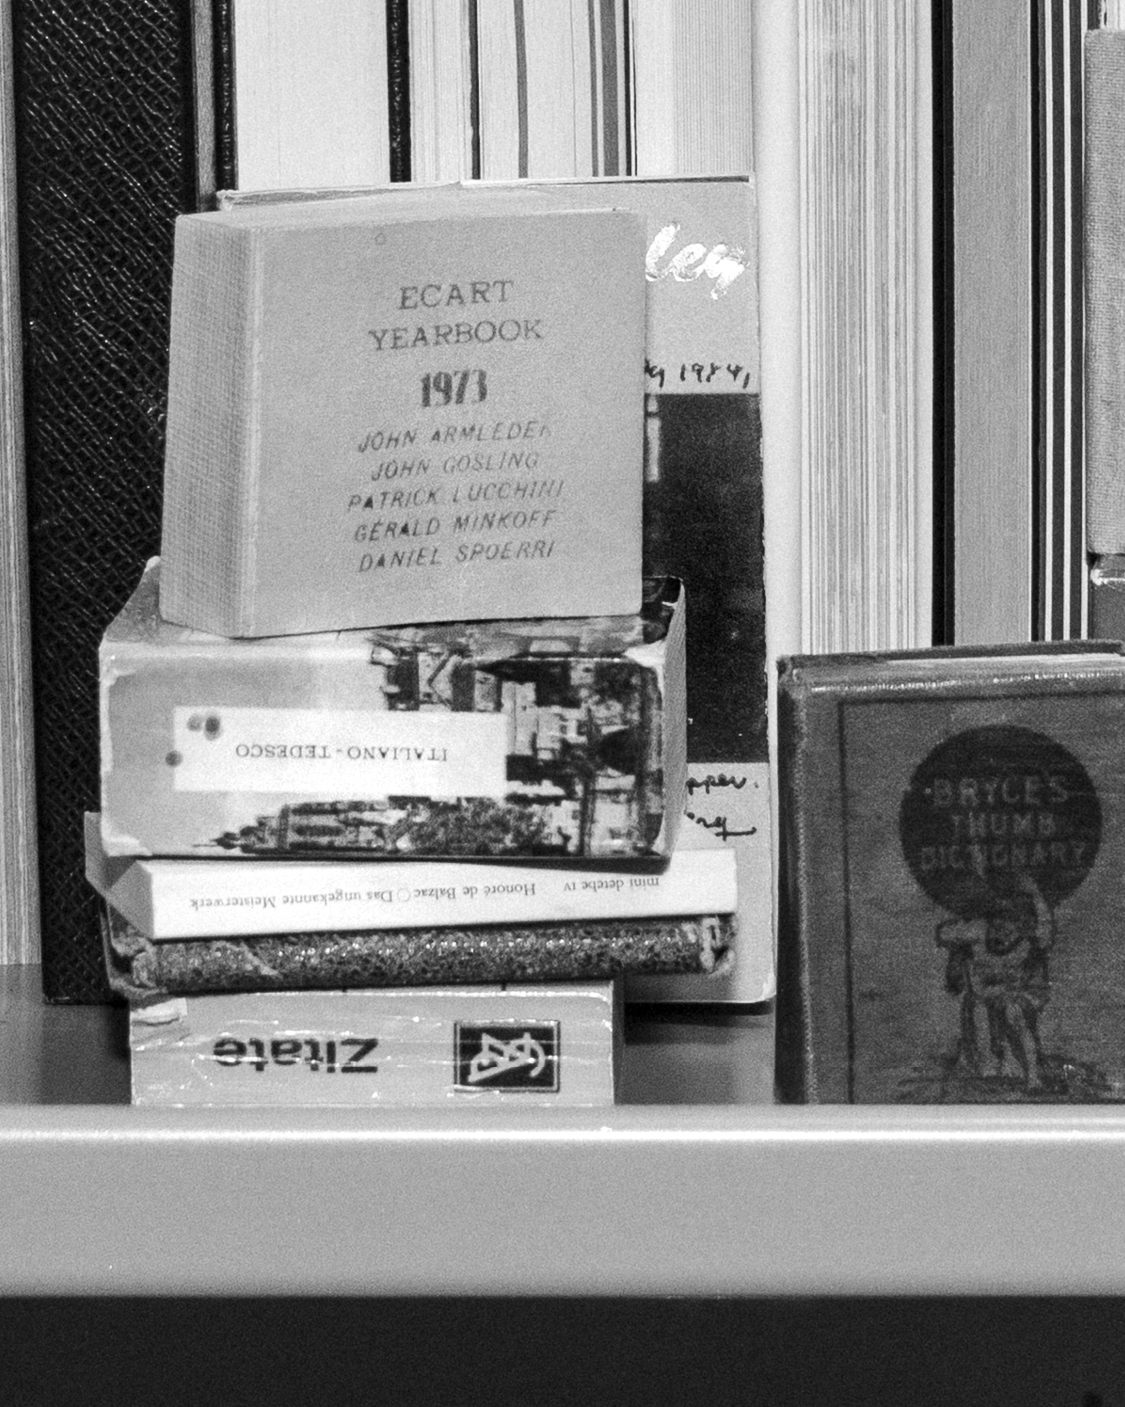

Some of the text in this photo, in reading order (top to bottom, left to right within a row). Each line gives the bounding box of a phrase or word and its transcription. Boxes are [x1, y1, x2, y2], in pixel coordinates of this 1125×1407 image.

[399, 279, 514, 310] ECART
[368, 319, 542, 351] YEARBOOK
[420, 369, 487, 407] 1973
[357, 430, 417, 452] JOHN
[371, 452, 539, 481] JOHN GOSLING
[348, 480, 564, 512] PATRICK LUCCHINI
[453, 510, 557, 534] MINKOFF
[359, 540, 555, 572] DANIEL SPOERRI
[236, 744, 331, 759] TEDESCO
[347, 746, 447, 762] ITALIANO
[952, 812, 1056, 837] THUMB
[413, 887, 456, 900] Balzac
[463, 885, 478, 896] de
[484, 883, 536, 896] Honoré
[582, 880, 624, 892] detebe
[630, 878, 660, 889] mini
[190, 896, 276, 911] Meisterwerk
[367, 890, 393, 902] Das
[213, 1038, 378, 1073] Zitate
